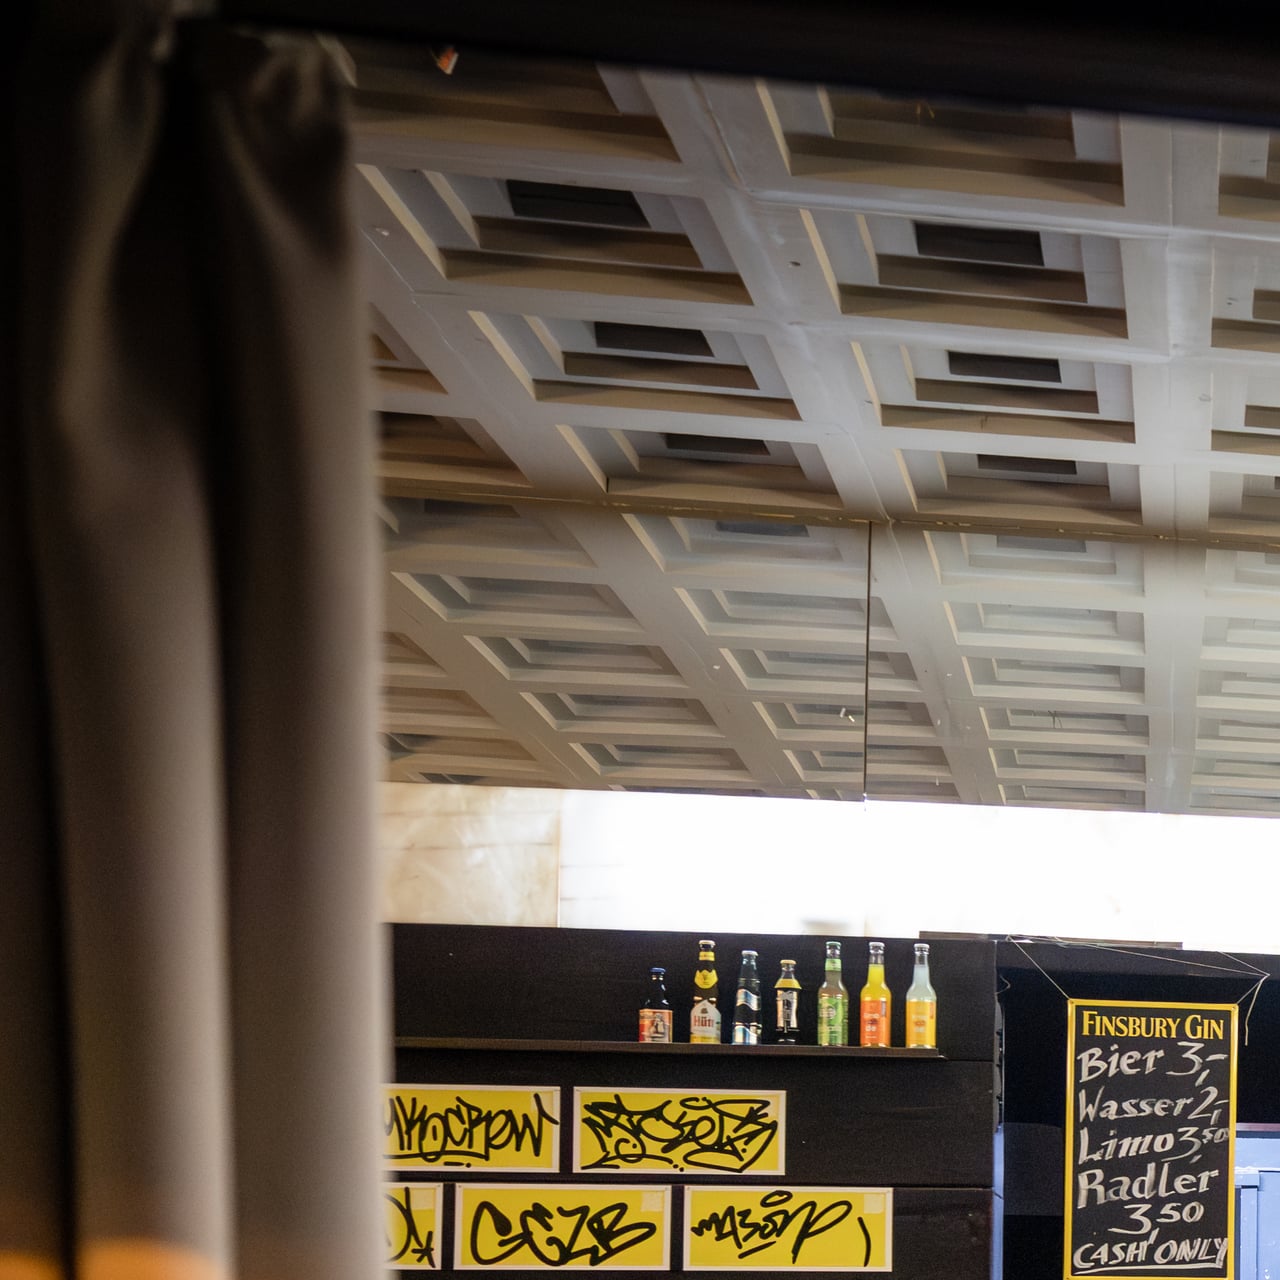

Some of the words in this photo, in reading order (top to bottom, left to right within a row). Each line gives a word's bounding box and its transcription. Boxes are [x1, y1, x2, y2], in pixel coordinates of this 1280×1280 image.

[1081, 1010, 1181, 1039] FINSBURY
[1184, 1014, 1225, 1041] GIN
[1076, 1044, 1164, 1084] Bier
[1078, 1086, 1193, 1123] Wasser
[1077, 1127, 1174, 1166] Limo
[1076, 1161, 1219, 1210] Radler
[1072, 1242, 1147, 1270] CASH
[1153, 1237, 1229, 1269] ONLY
